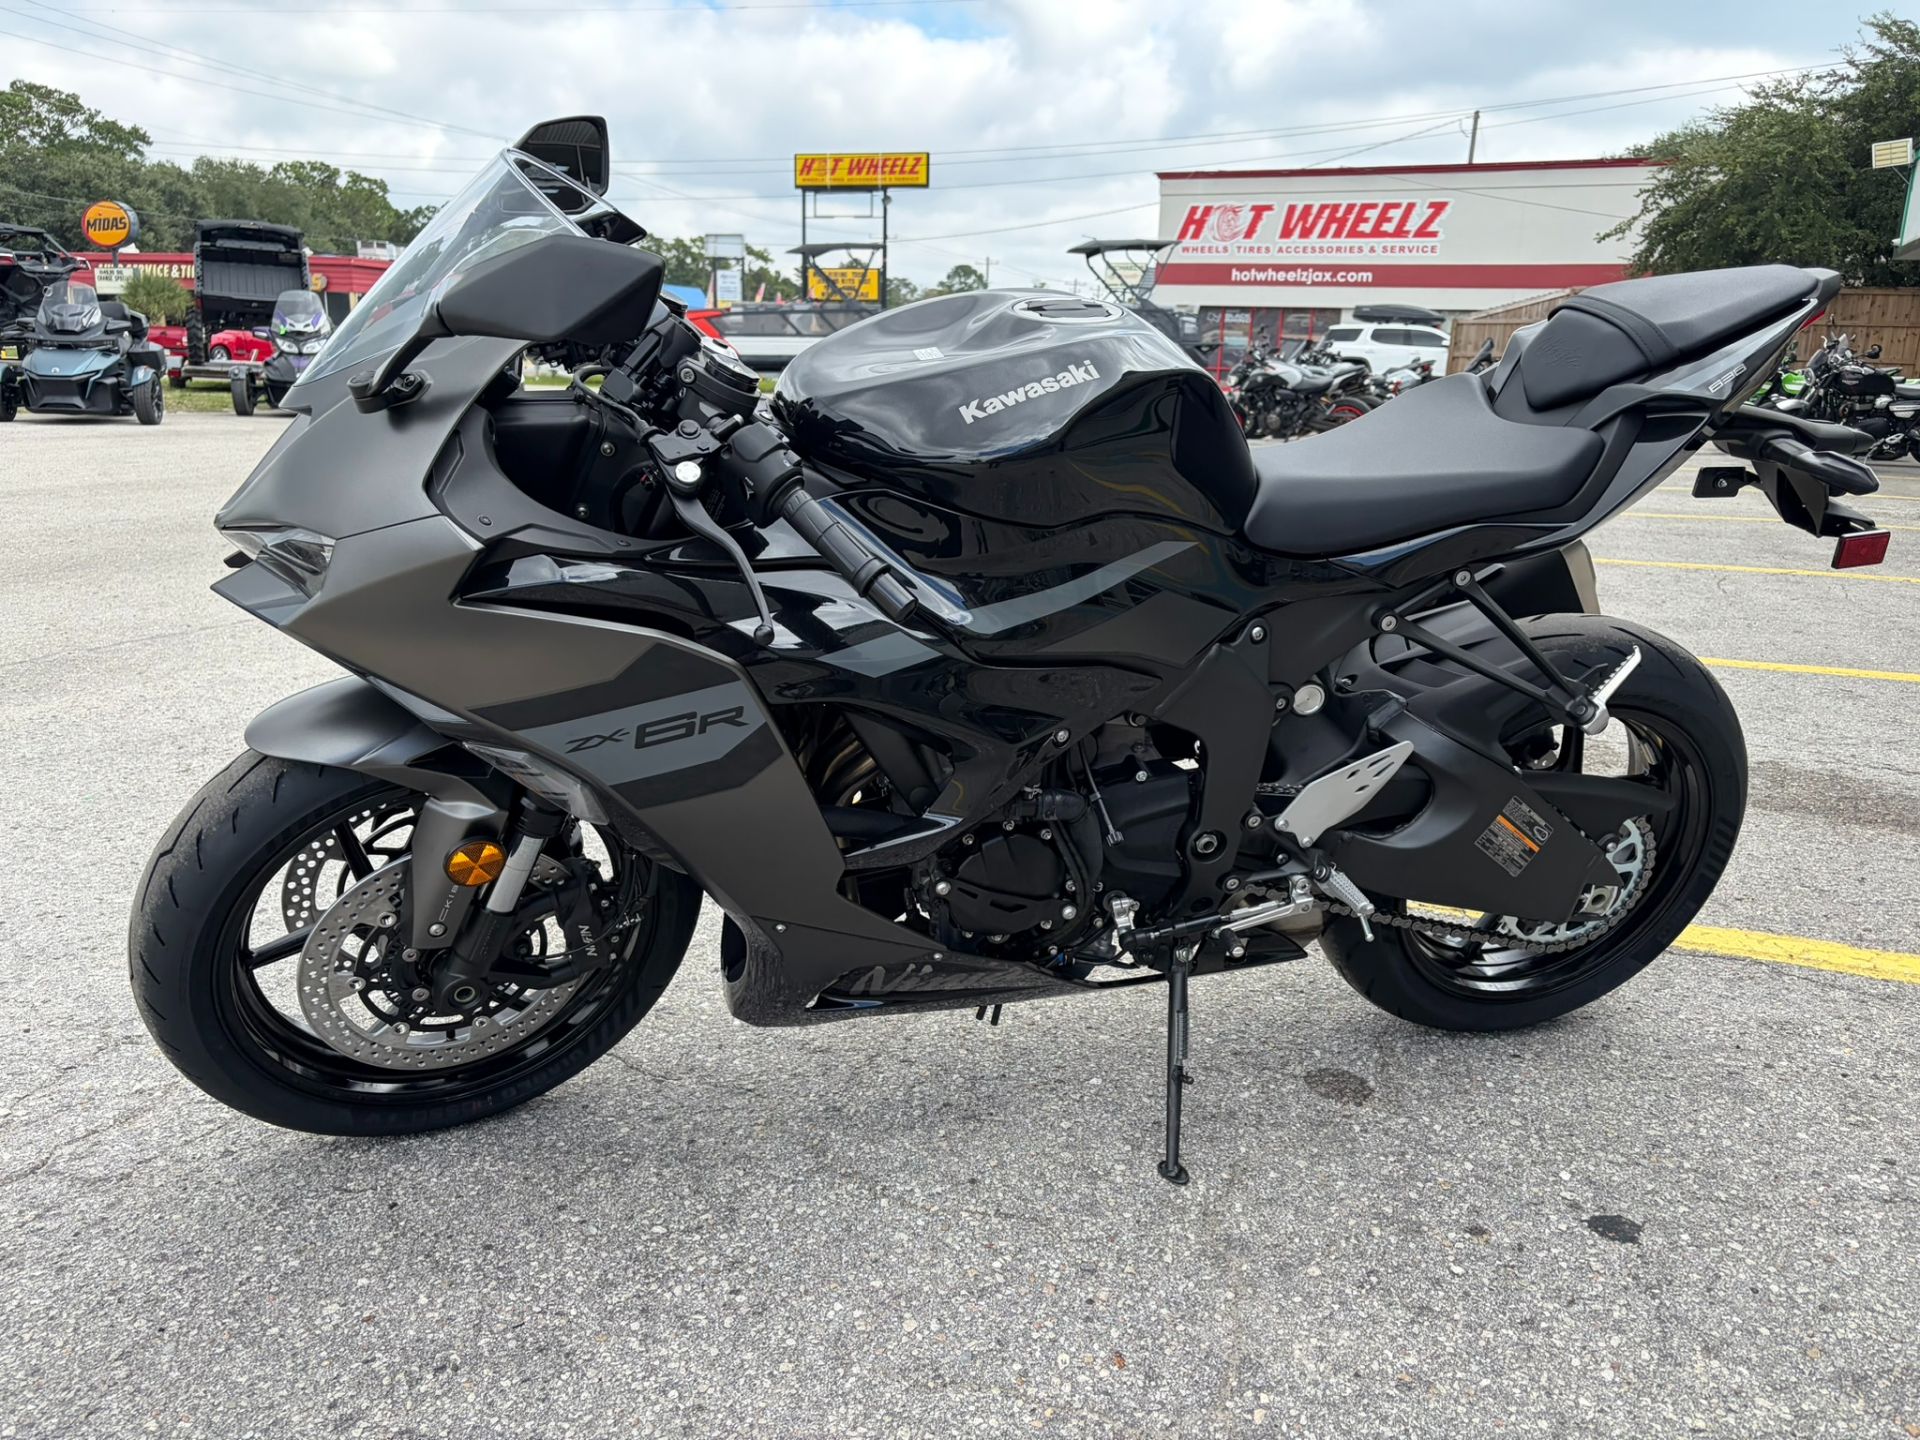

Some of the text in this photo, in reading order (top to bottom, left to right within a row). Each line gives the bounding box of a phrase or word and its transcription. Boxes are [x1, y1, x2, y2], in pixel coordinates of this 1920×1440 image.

[847, 156, 923, 176] WHEELZ
[86, 216, 127, 232] MIDAS
[1177, 201, 1449, 242] HOT WHEELZ
[1181, 245, 1439, 254] WHEELS TIRES ACCESSORIES & SERVICE
[1231, 268, 1373, 285] hotwheelzjax.com
[959, 359, 1101, 425] Kawasaki
[565, 705, 750, 754] ZX-6R
